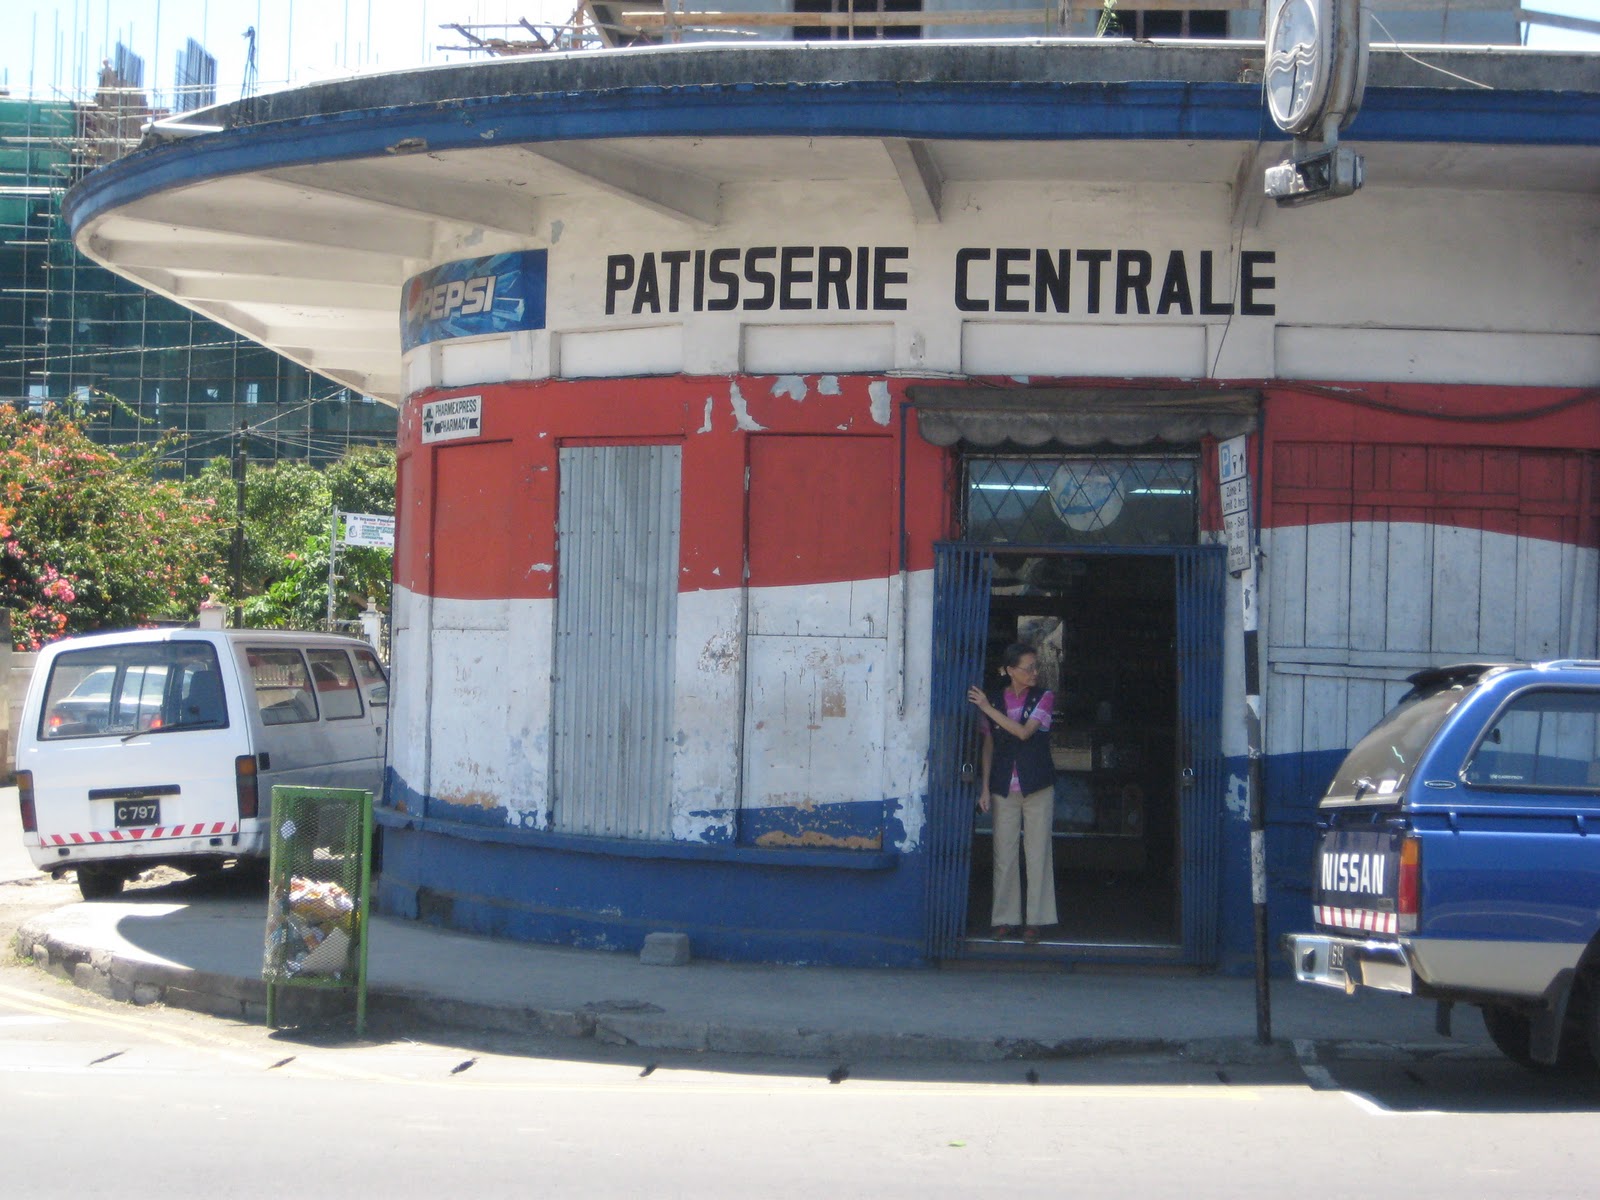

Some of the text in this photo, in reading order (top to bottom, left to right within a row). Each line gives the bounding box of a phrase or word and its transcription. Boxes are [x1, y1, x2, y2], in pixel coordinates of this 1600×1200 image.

[605, 246, 1276, 315] PATISSERIE CENTRALE
[420, 275, 497, 323] PEPSI
[435, 399, 477, 417] PHARMEXPRESS
[440, 416, 469, 433] PHARMACY
[117, 805, 157, 820] C 797
[1321, 853, 1385, 894] NISSAN
